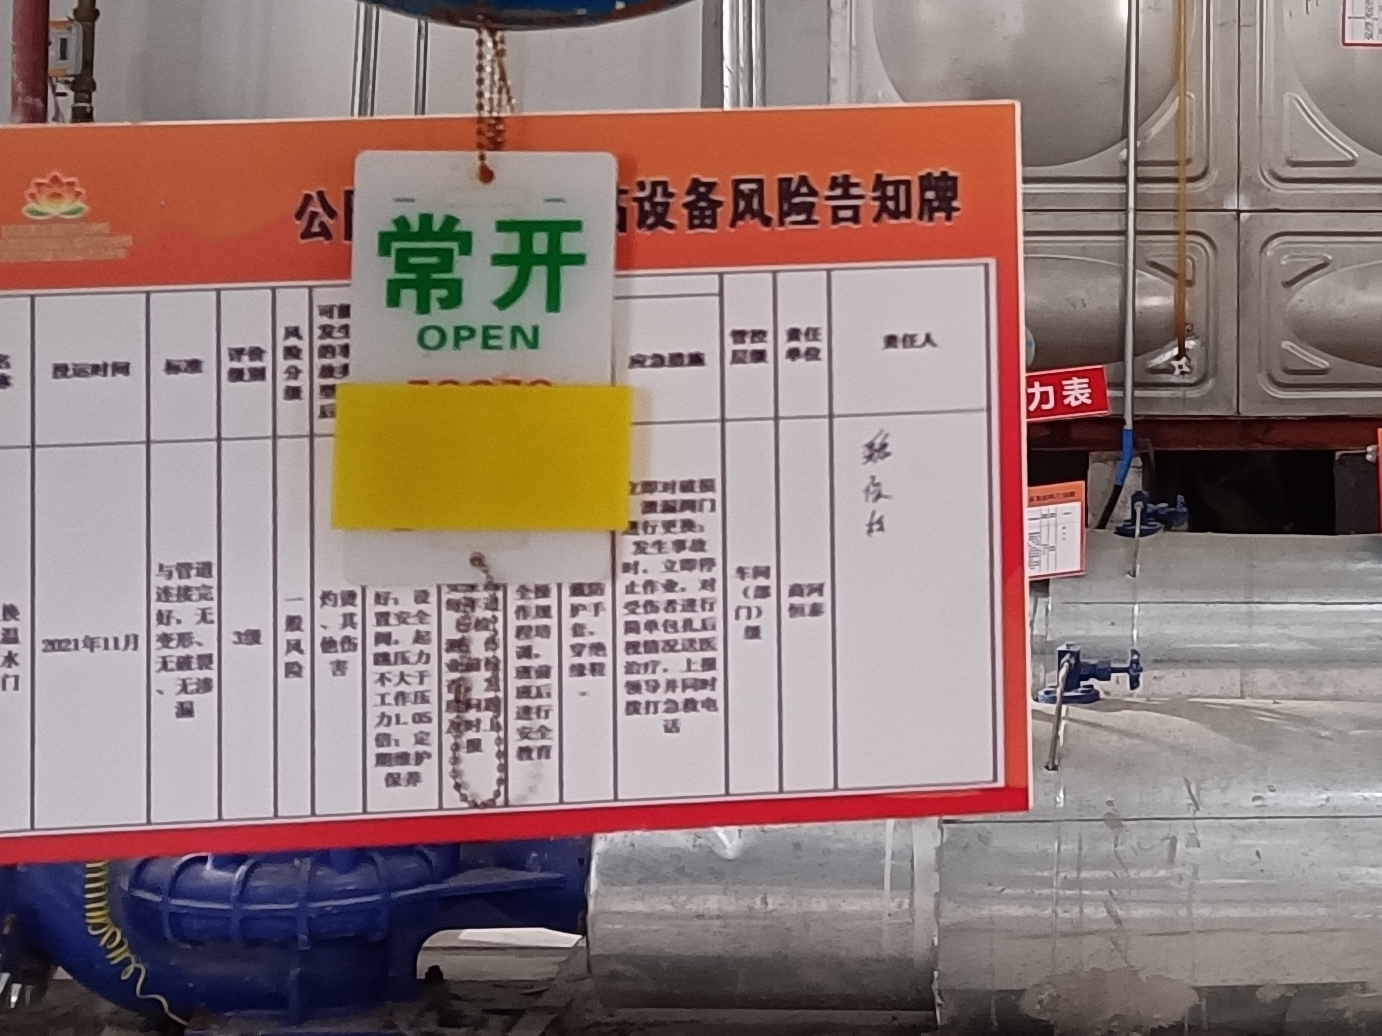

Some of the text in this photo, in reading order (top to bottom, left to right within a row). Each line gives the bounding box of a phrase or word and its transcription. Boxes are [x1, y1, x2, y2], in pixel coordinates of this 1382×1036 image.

[378, 213, 586, 314] 常开
[417, 324, 539, 350] OPEN
[1027, 377, 1092, 412] 力表
[42, 634, 138, 653] 2021年11月
